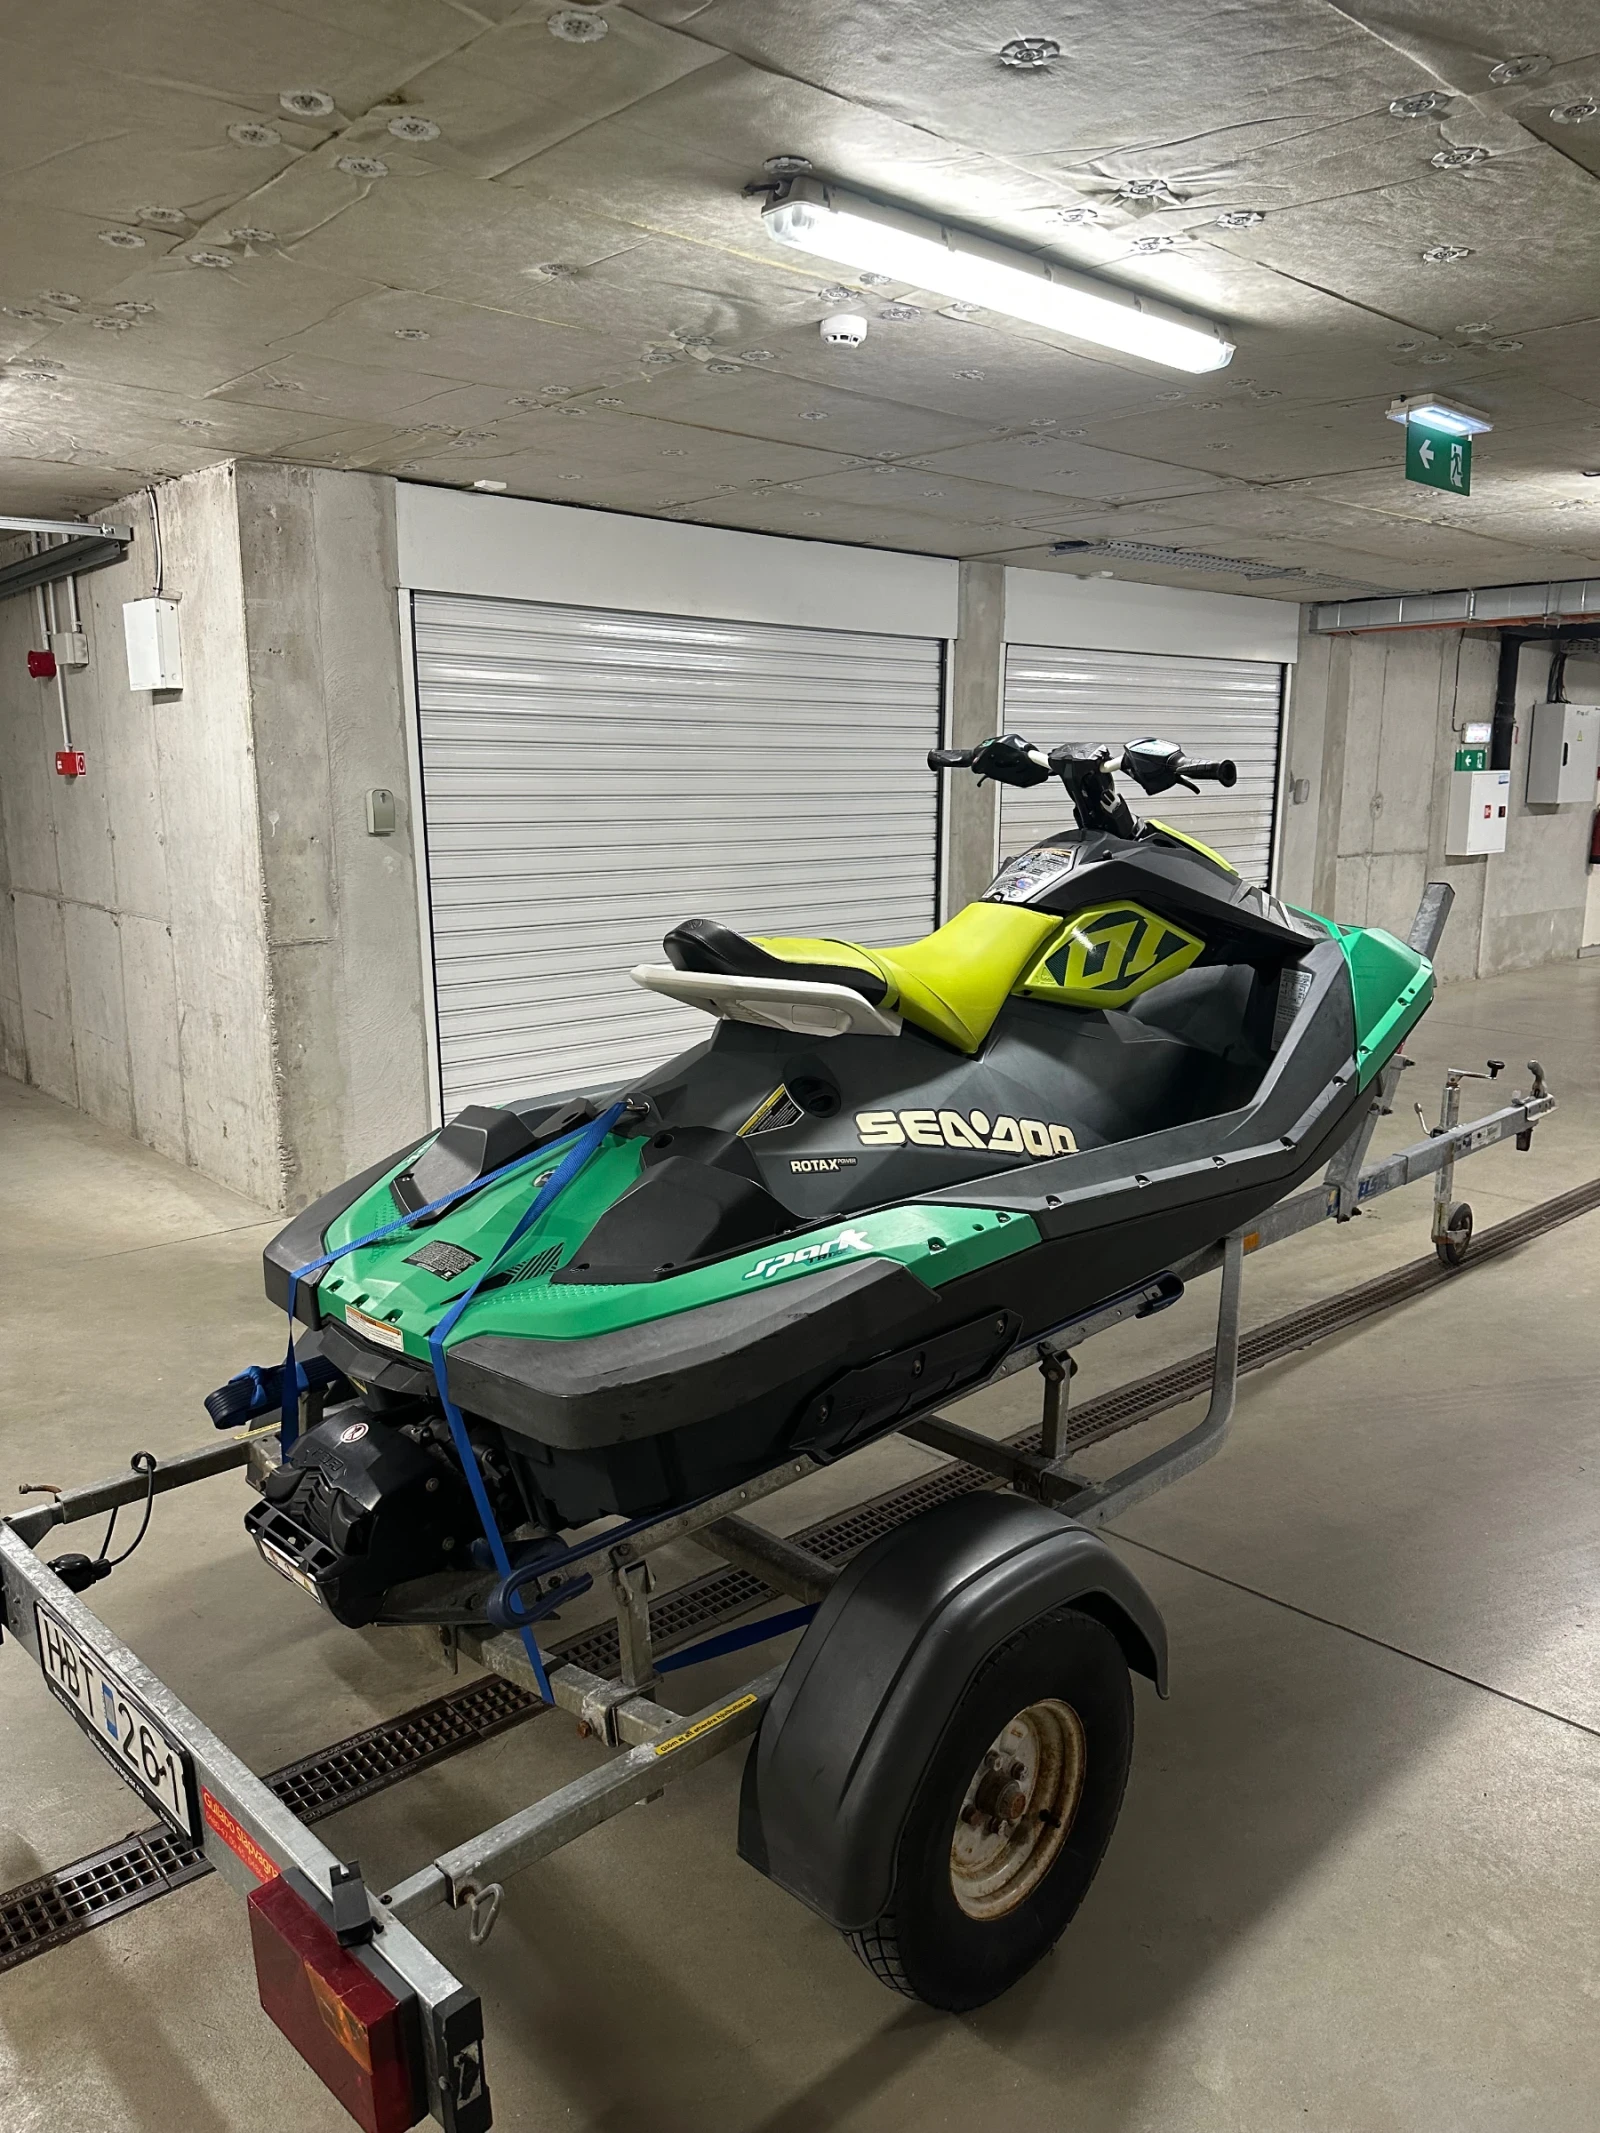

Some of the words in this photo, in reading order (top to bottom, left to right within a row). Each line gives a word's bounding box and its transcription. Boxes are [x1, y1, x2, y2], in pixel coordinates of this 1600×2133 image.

[790, 1158, 839, 1173] ROTAX
[838, 1157, 857, 1165] POWER
[44, 1618, 94, 1718] HBT
[117, 1702, 181, 1815] 261
